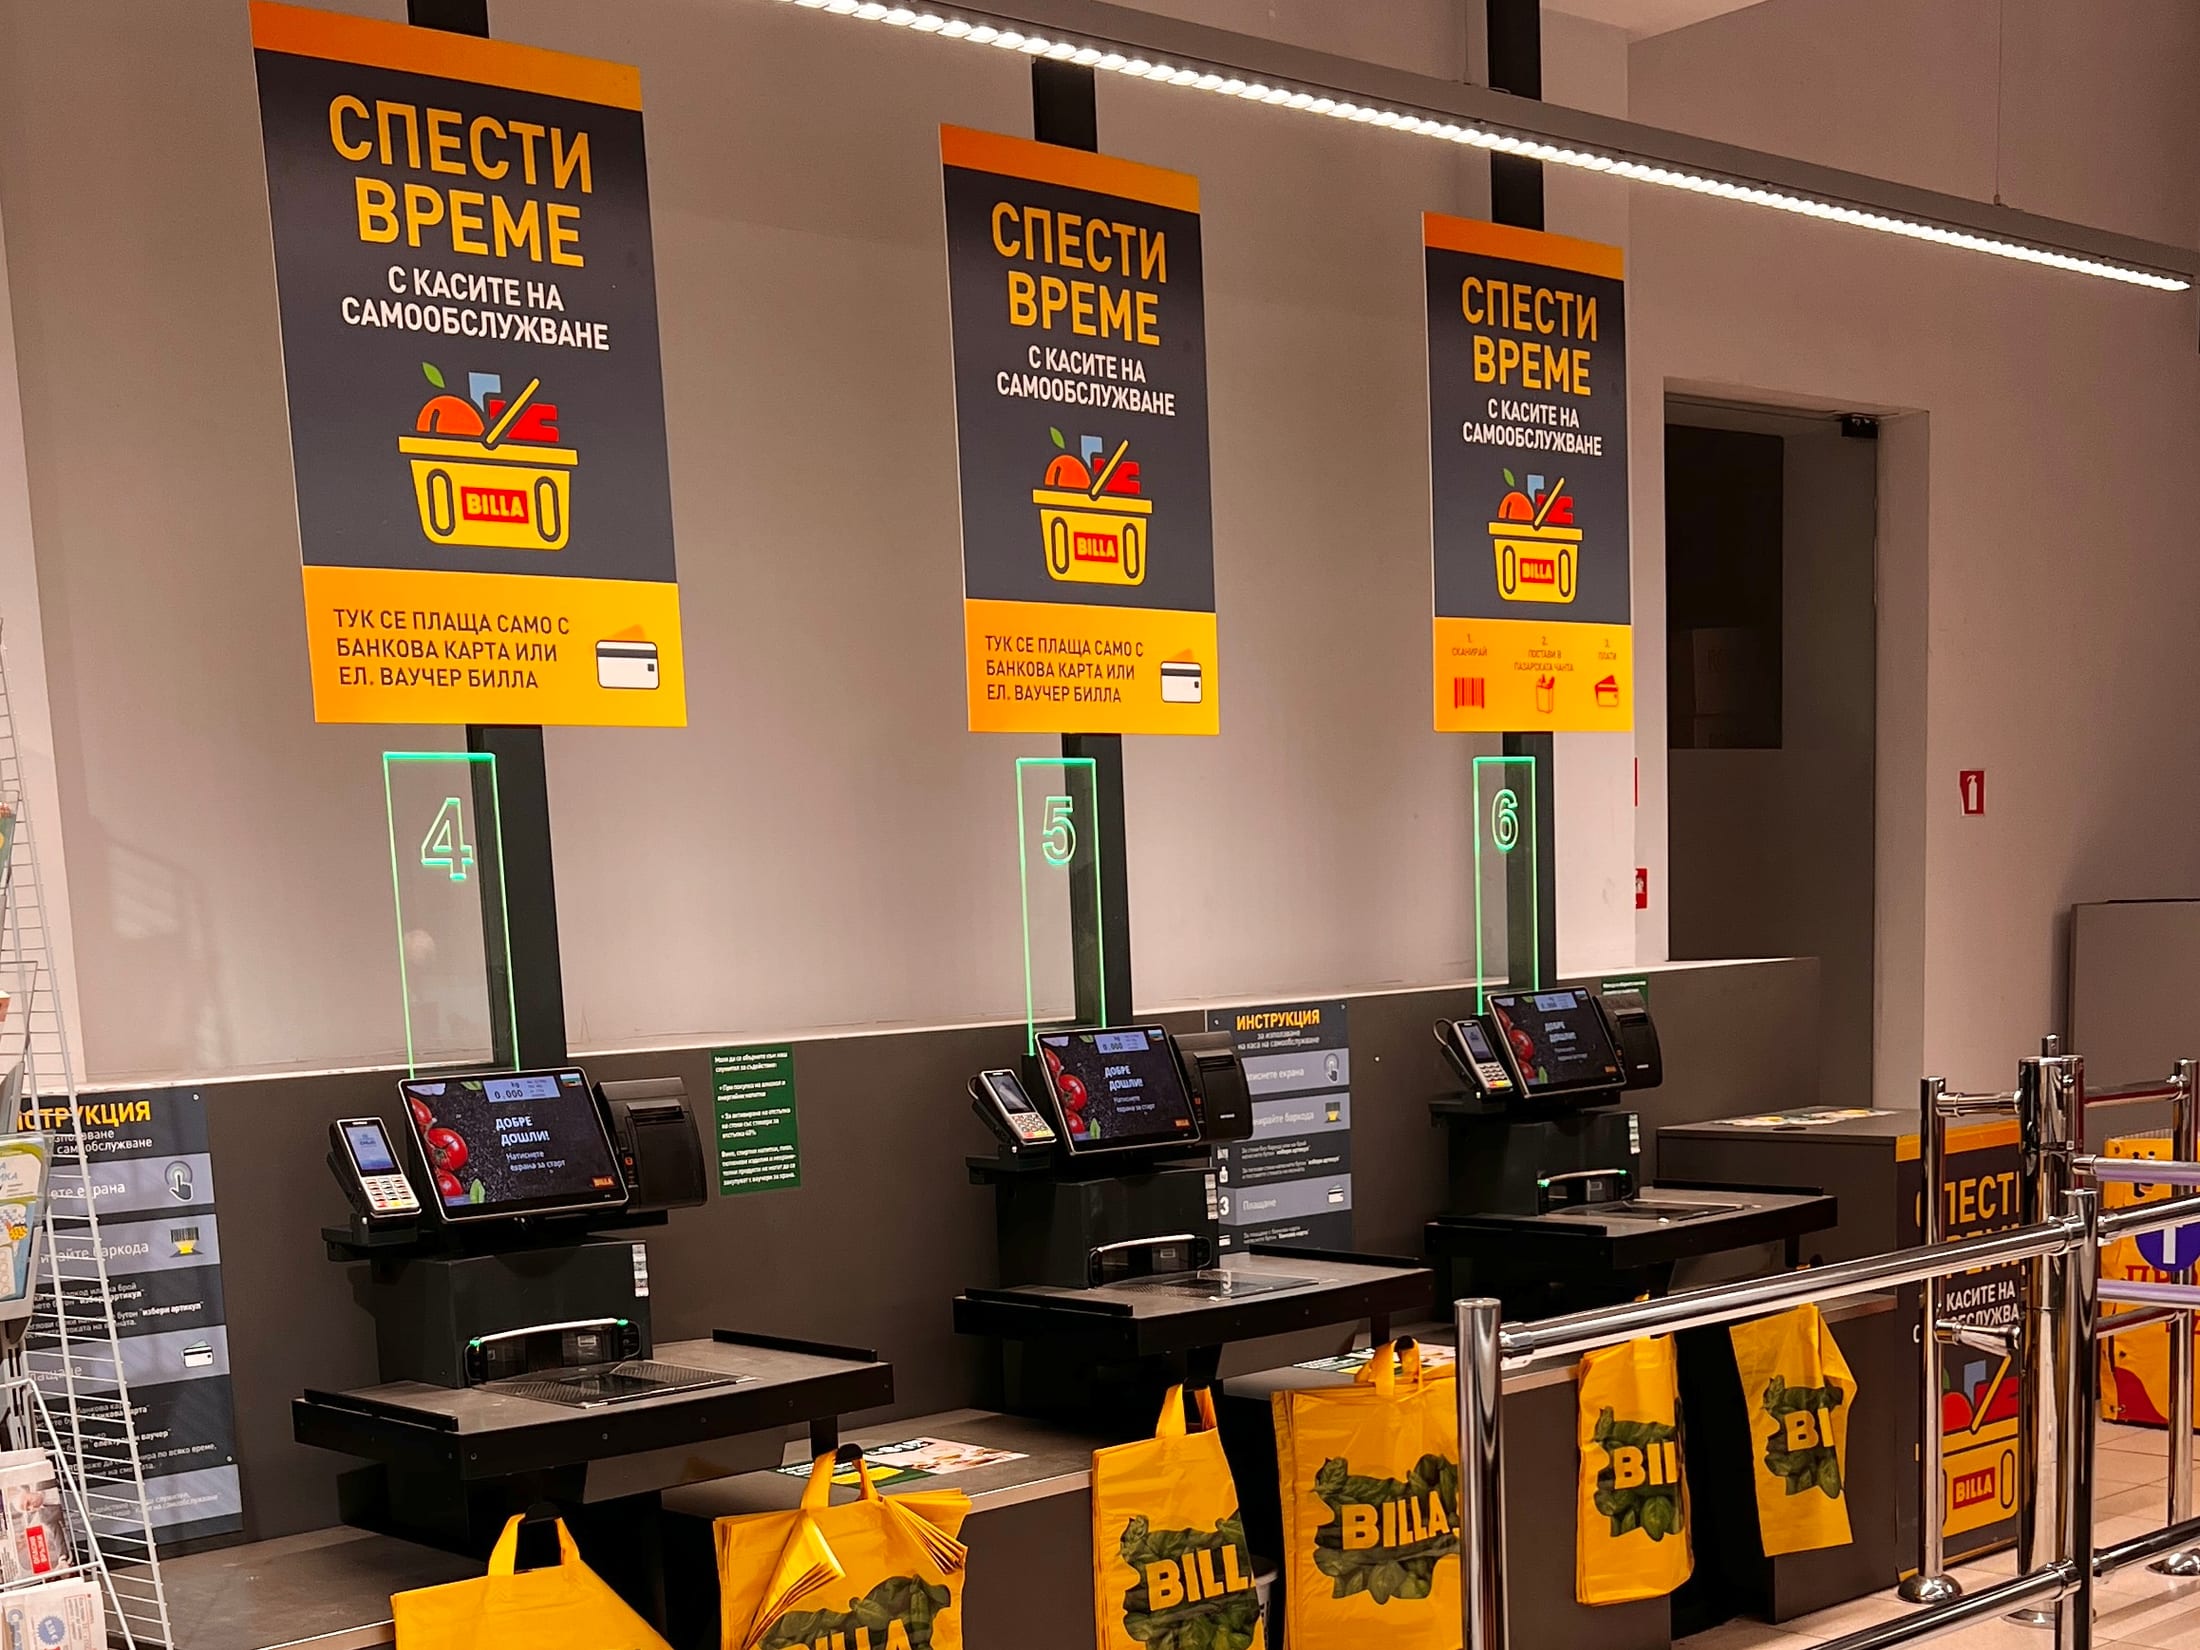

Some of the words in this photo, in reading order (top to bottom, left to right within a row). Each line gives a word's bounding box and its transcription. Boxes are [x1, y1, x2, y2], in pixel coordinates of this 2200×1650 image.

[328, 94, 592, 194] СПЕСТИ
[355, 176, 585, 268] ВРЕМЕ
[991, 202, 1167, 283] СПЕСТИ
[388, 265, 406, 294] С
[413, 268, 521, 308] КАСИТЕ
[526, 280, 565, 312] НА
[1008, 270, 1160, 346] ВРЕМЕ
[1461, 276, 1597, 342] СПЕСТИ
[341, 297, 610, 351] САМООБСЛУЖВАНЕ
[1028, 345, 1041, 369] С
[1046, 347, 1117, 379] КАСИТЕ
[1121, 357, 1146, 384] НА
[1473, 335, 1591, 396] ВРЕМЕ
[996, 371, 1176, 417] САМООБСЛУЖВАНЕ
[1488, 398, 1498, 419] С
[1501, 400, 1557, 426] КАСИТЕ
[1560, 408, 1580, 429] НА
[1462, 421, 1602, 456] САМООБСЛУЖВАНЕ
[466, 492, 525, 518] BILLA
[1077, 538, 1116, 557] BILLA
[1522, 563, 1553, 579] BILLA
[333, 608, 373, 629] ТУК
[379, 611, 407, 631] СЕ
[412, 612, 489, 636] ПЛАЩА
[496, 614, 552, 634] САМО
[557, 616, 570, 635] С
[336, 638, 439, 659] БАНКОВА
[445, 641, 511, 661] КАРТА
[516, 643, 558, 662] ИЛИ
[985, 635, 1013, 653] ТУК
[1016, 637, 1034, 653] СЕ
[1038, 638, 1091, 657] ПЛАЩА
[1095, 640, 1132, 657] САМО
[1135, 642, 1144, 657] С
[339, 666, 374, 686] ЕЛ.
[380, 668, 462, 688] ВАУЧЕР
[468, 669, 538, 689] БИЛЛА
[986, 660, 1054, 678] БАНКОВА
[1058, 662, 1102, 679] КАРТА
[1106, 664, 1135, 680] ИЛИ
[987, 684, 1010, 700] ЕЛ.
[1015, 685, 1070, 702] ВАУЧЕР
[1074, 686, 1121, 703] БИЛЛА
[1042, 796, 1076, 865] 5
[1492, 789, 1519, 852] 6
[420, 796, 474, 881] 4
[1236, 1009, 1320, 1031] ИНСТРУКЦИЯ
[1104, 1065, 1132, 1078] ДОБРЕ
[1110, 1078, 1144, 1092] ДОШЛИ!
[495, 1116, 533, 1131] ДОБРЕ
[501, 1130, 550, 1146] ДОШЛИ!
[57, 1138, 153, 1155] самобслужване
[506, 1151, 545, 1162] Натиснете
[77, 1183, 126, 1200] ерана
[1220, 1196, 1230, 1216] 3
[1916, 1171, 2020, 1227] ПЕСТ
[1946, 1284, 1996, 1312] КАСИТЕ
[1998, 1280, 2016, 1300] НА
[1954, 1473, 1993, 1504] BILLA
[1341, 1490, 1450, 1551] BILLA
[1145, 1543, 1257, 1611] BILL
